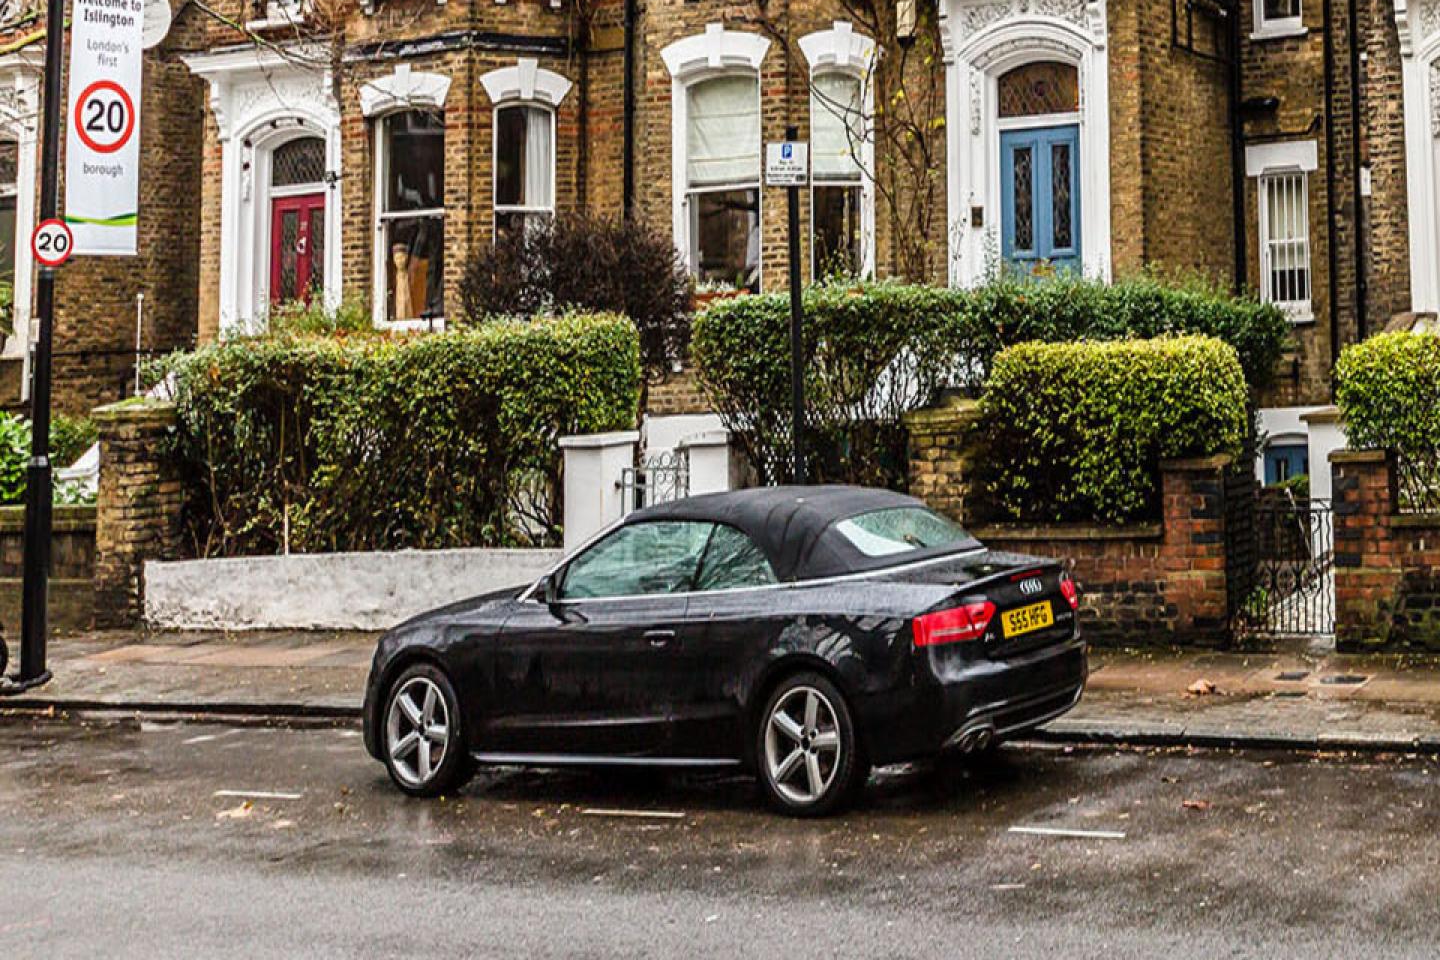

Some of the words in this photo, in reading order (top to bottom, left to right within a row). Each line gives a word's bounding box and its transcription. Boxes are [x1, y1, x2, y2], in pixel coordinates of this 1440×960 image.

[131, 0, 142, 12] to
[84, 8, 134, 27] Islington
[87, 38, 129, 54] London's
[97, 53, 118, 68] first
[86, 99, 124, 133] 20
[83, 161, 124, 178] borough
[38, 232, 68, 253] 20
